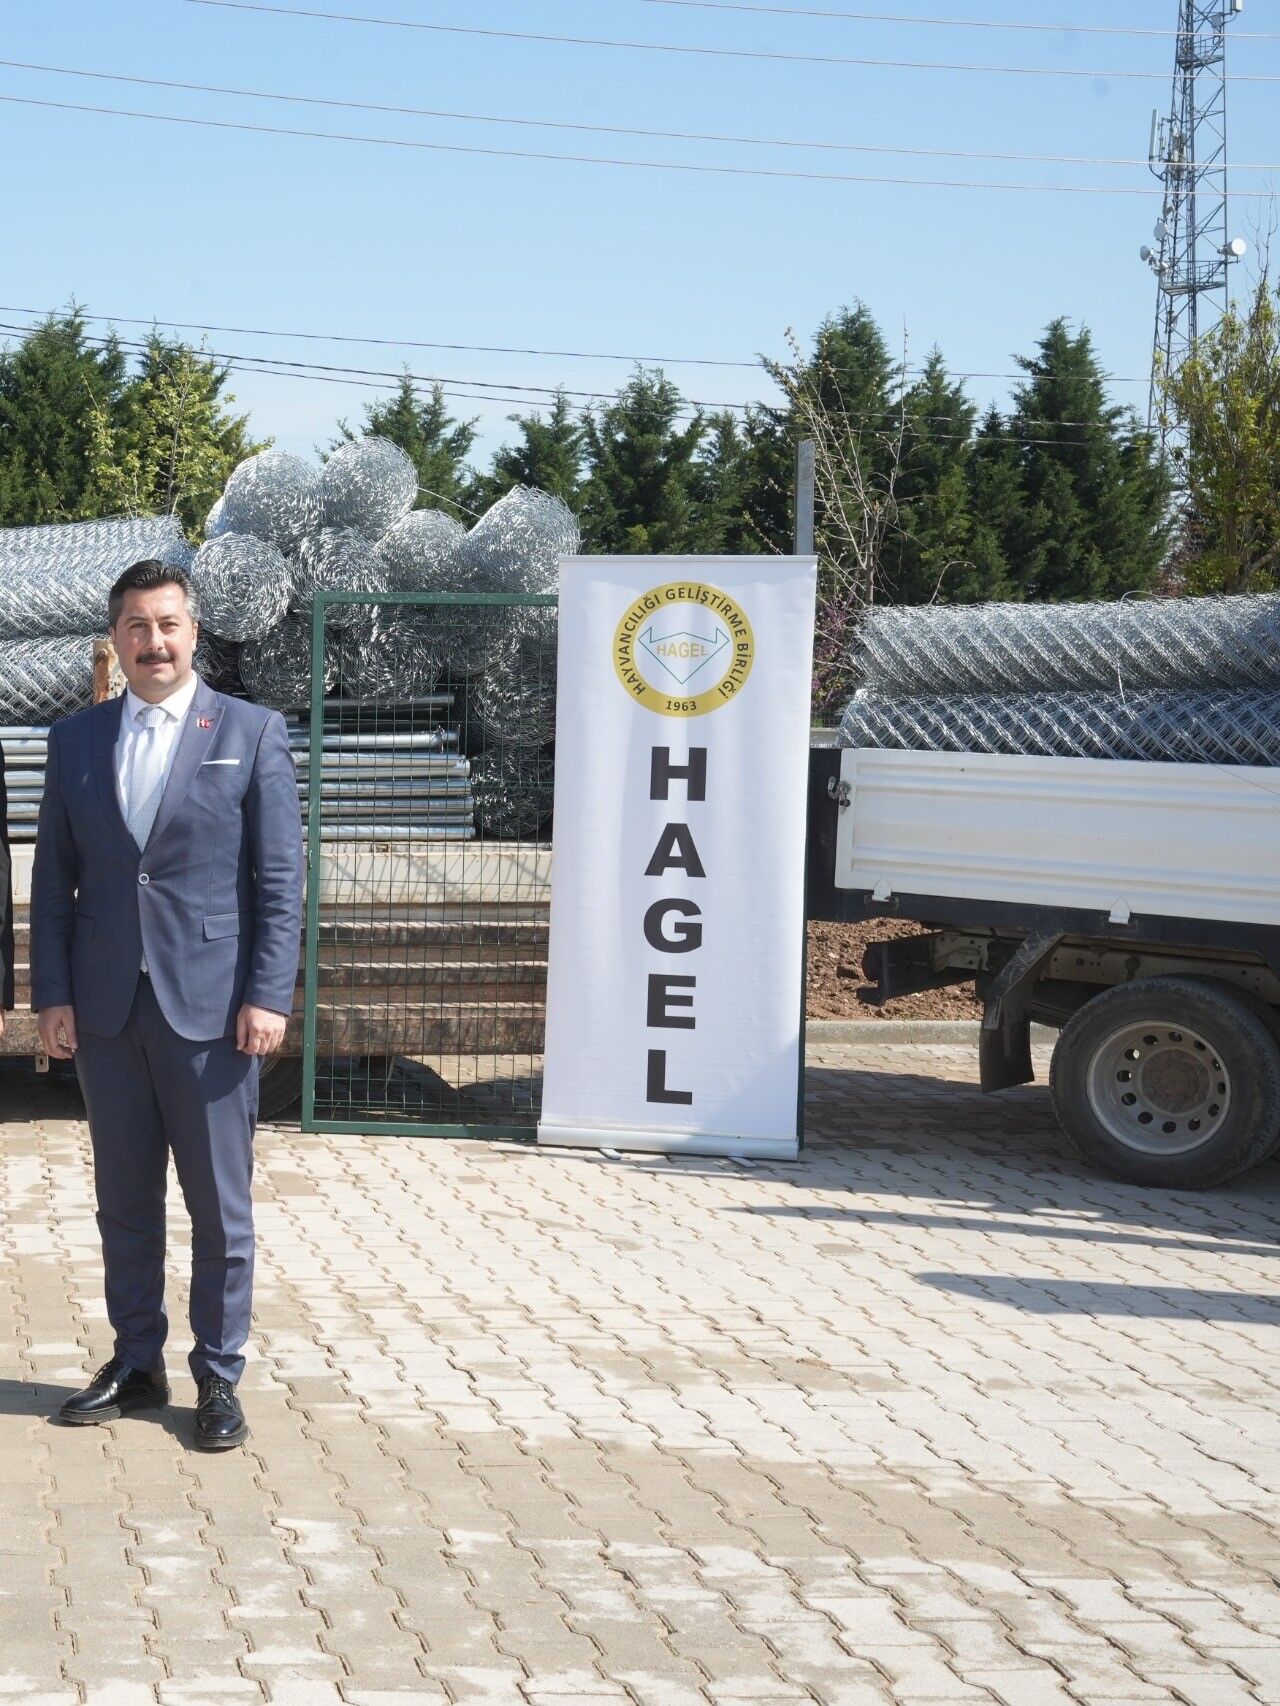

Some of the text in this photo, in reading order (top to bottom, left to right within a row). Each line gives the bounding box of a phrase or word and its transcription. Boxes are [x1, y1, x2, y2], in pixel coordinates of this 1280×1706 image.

[619, 586, 751, 699] HAYVANCILIĞI GELİŞTİRME BİRLİĞİ
[656, 641, 709, 658] HAGEL
[665, 700, 697, 711] 1963
[643, 746, 707, 1105] HAGEL
